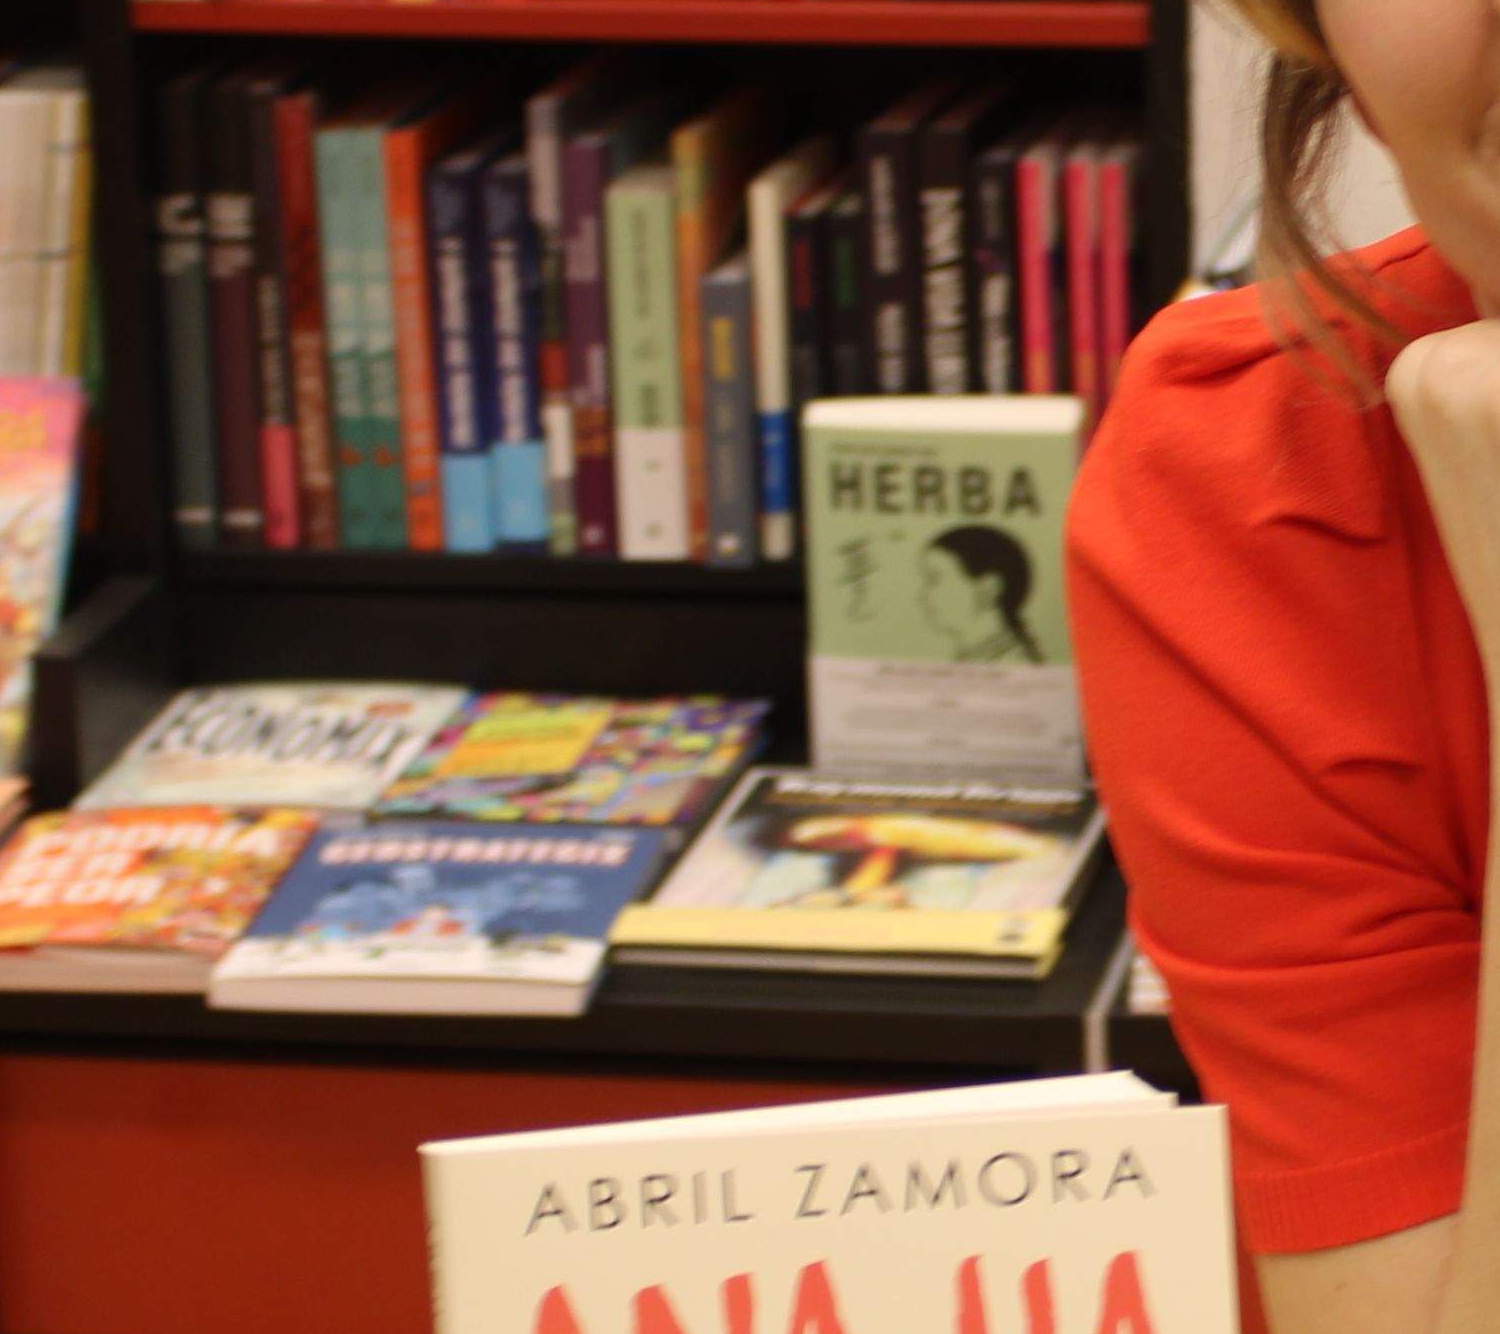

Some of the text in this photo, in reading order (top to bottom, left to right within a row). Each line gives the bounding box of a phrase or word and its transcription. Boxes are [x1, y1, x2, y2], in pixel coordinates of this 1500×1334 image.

[828, 462, 1042, 517] HERBA
[524, 1147, 1157, 1236] ABRIL ZAMORA
